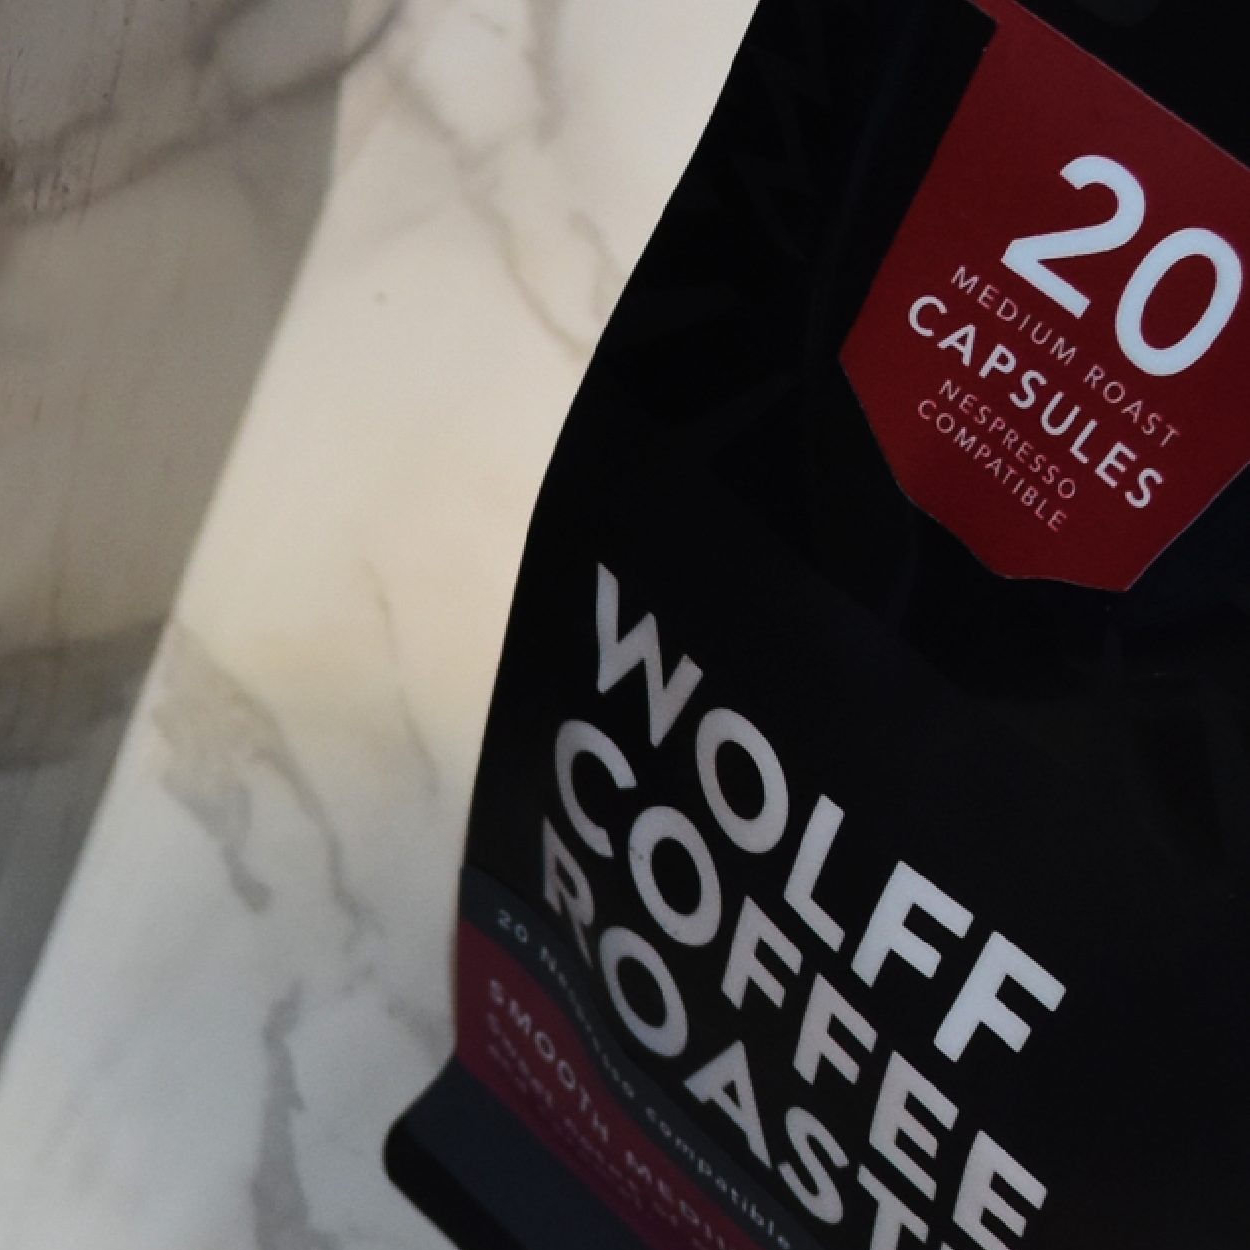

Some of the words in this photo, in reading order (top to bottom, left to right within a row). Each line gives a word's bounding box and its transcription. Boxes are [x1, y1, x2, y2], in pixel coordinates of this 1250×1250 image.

[1001, 155, 1242, 376] 20
[908, 296, 1163, 508] CAPSULES
[938, 379, 1077, 499] NESPRESSO
[950, 265, 1078, 366] MEDIUM
[1083, 364, 1180, 447] ROAST
[917, 400, 1067, 532] COMPATIBLE
[594, 561, 1066, 1062] WOLFF
[497, 908, 530, 944] 20
[488, 978, 610, 1145] SMOOTH
